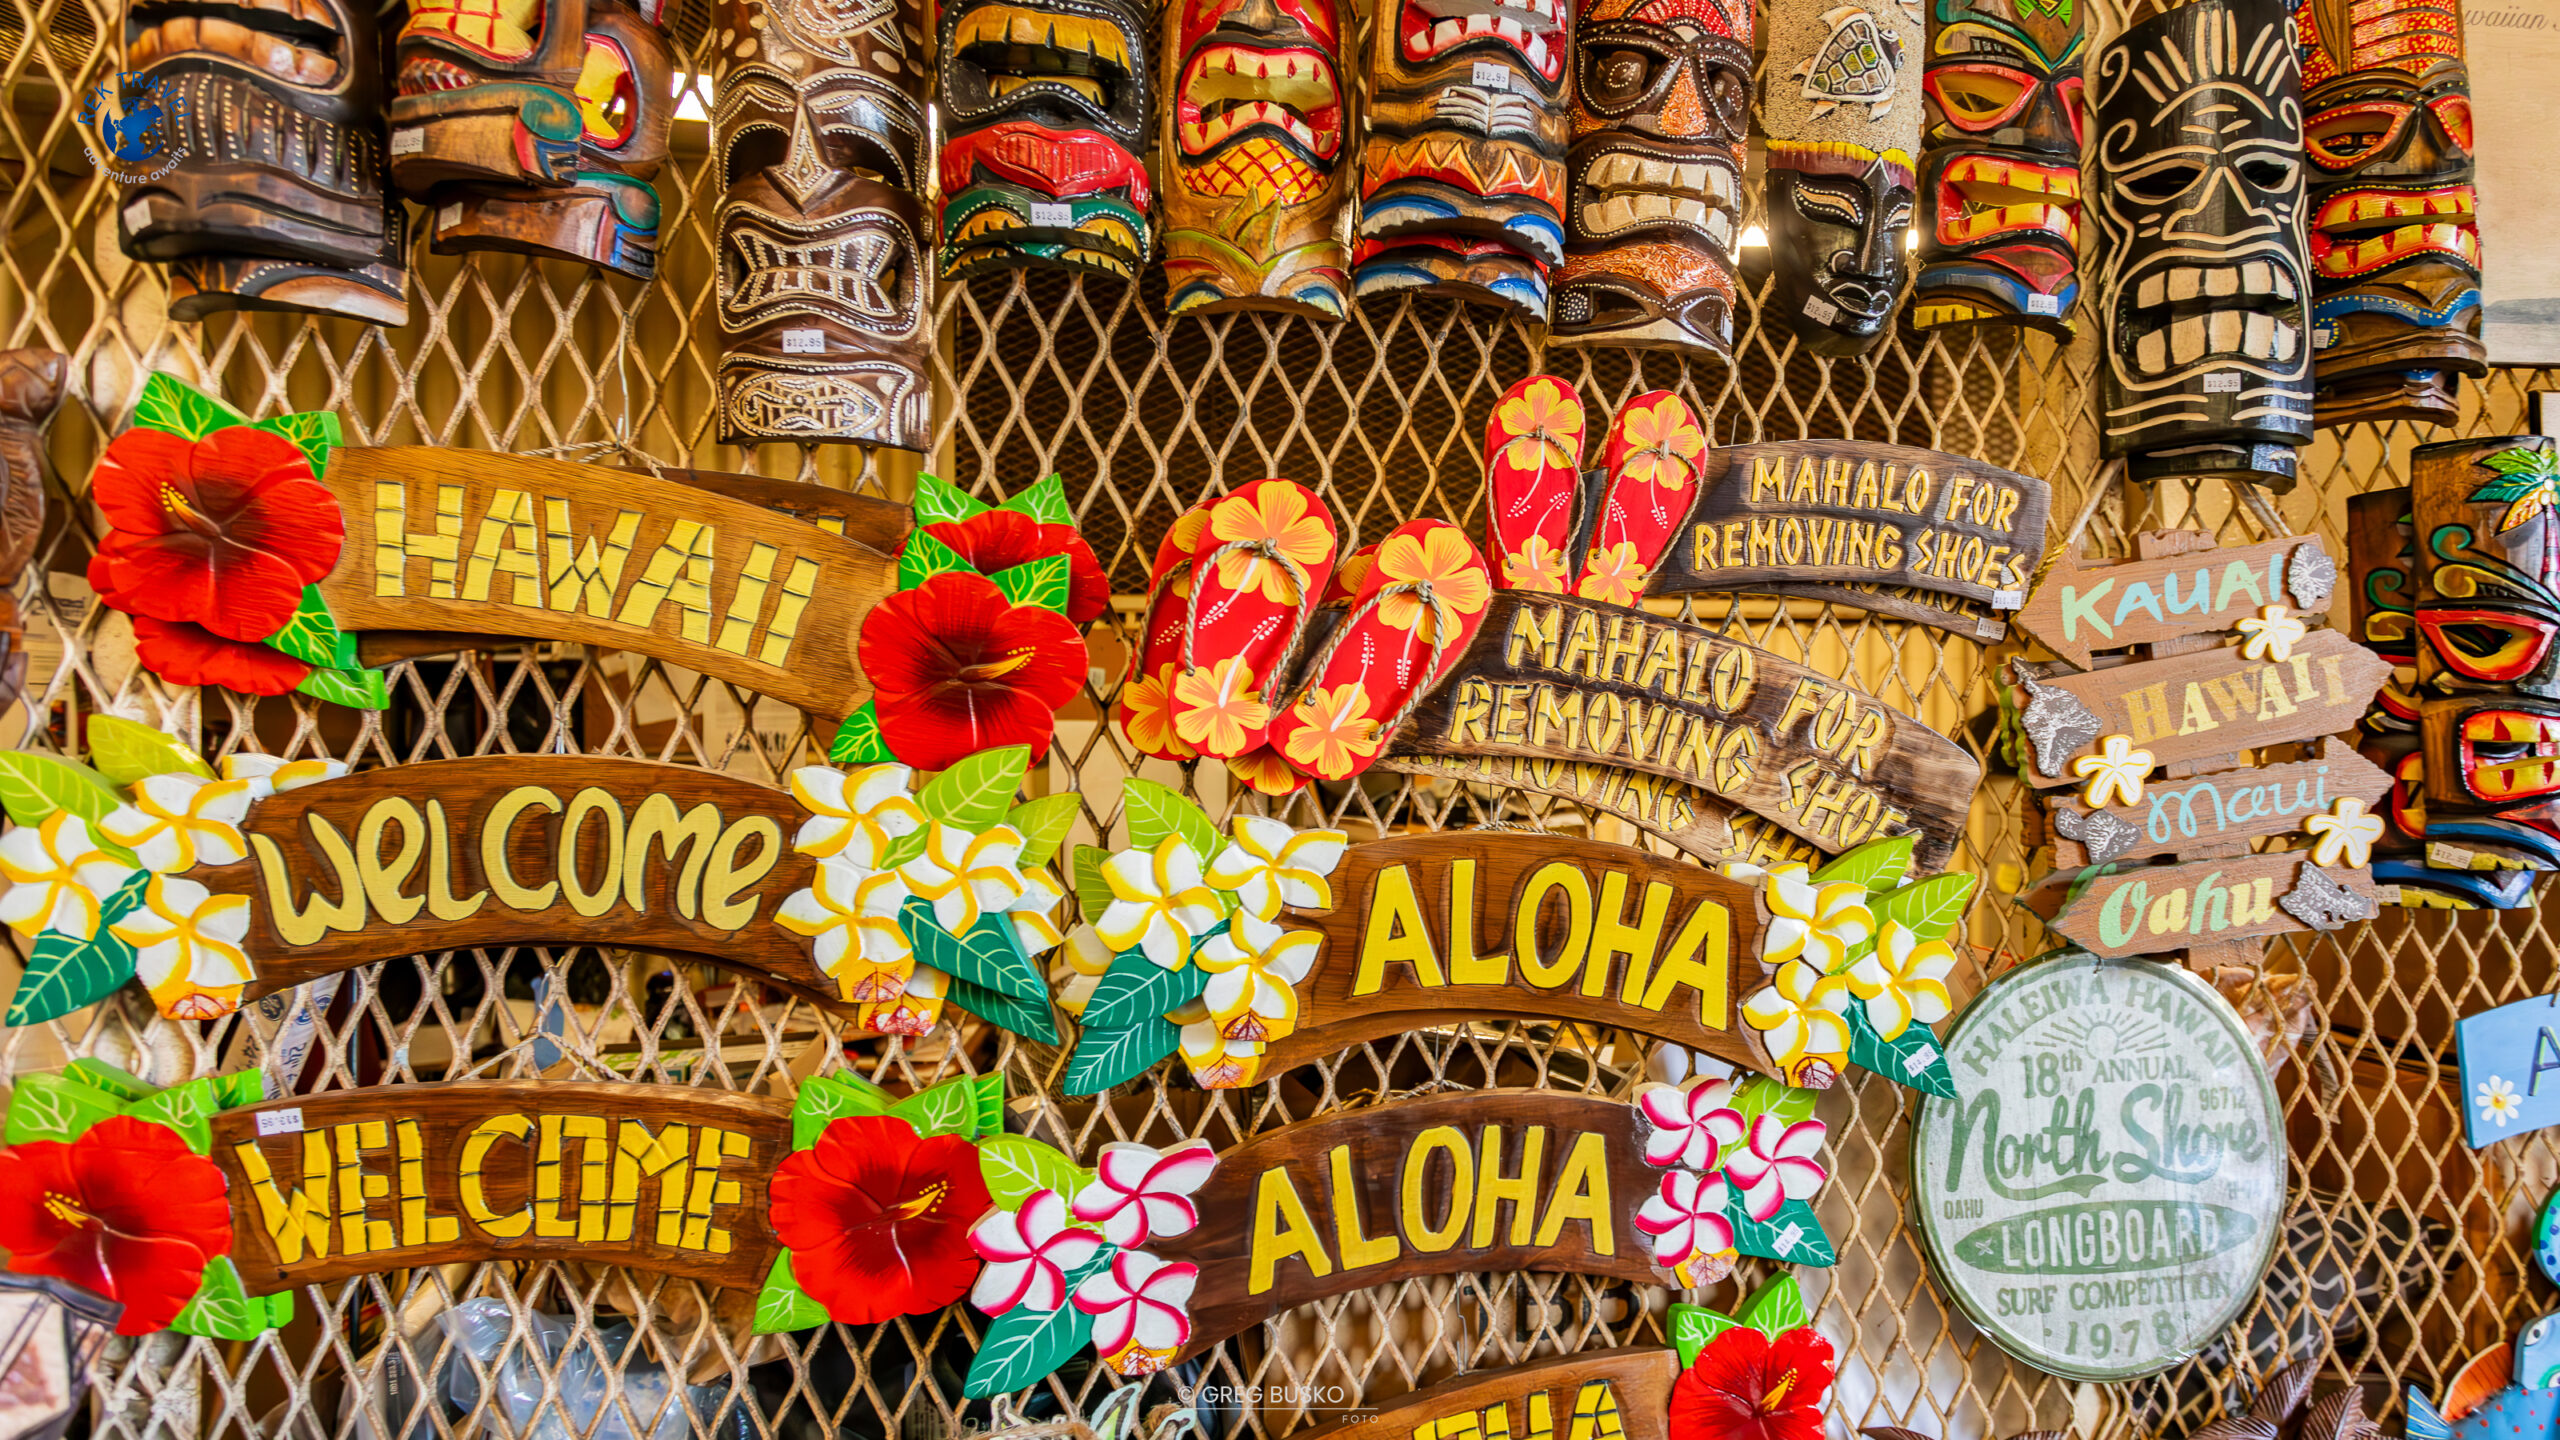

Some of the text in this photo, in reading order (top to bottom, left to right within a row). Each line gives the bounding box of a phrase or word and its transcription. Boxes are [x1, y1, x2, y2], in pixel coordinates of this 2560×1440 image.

[1751, 456, 2019, 533] MAHALO FOR
[374, 481, 820, 668] HAWAII
[1694, 517, 2026, 592] REMOVING SHOES
[2061, 553, 2284, 642] KAUAI
[1504, 603, 1886, 772] MAHALO FOR
[2121, 652, 2353, 746] HAWAII
[1449, 676, 1924, 850] REMOVING SHOE
[1352, 857, 1730, 1031] ALOHA
[2098, 871, 2277, 948] Oahu
[1961, 974, 2240, 1077] HALEIWA HAWAII
[2019, 1049, 2192, 1099] 18th ANNUAL
[2198, 1086, 2247, 1112] 96712
[1936, 1082, 2268, 1200] North Shore
[233, 1113, 752, 1265] WELCOME
[1248, 1124, 1615, 1295] ALOHA
[1943, 1198, 1984, 1221] OAHU
[2000, 1206, 2220, 1268] LONGBOARD
[1996, 1273, 2232, 1318] SURF COMPETITION
[2064, 1309, 2178, 1360] 1978
